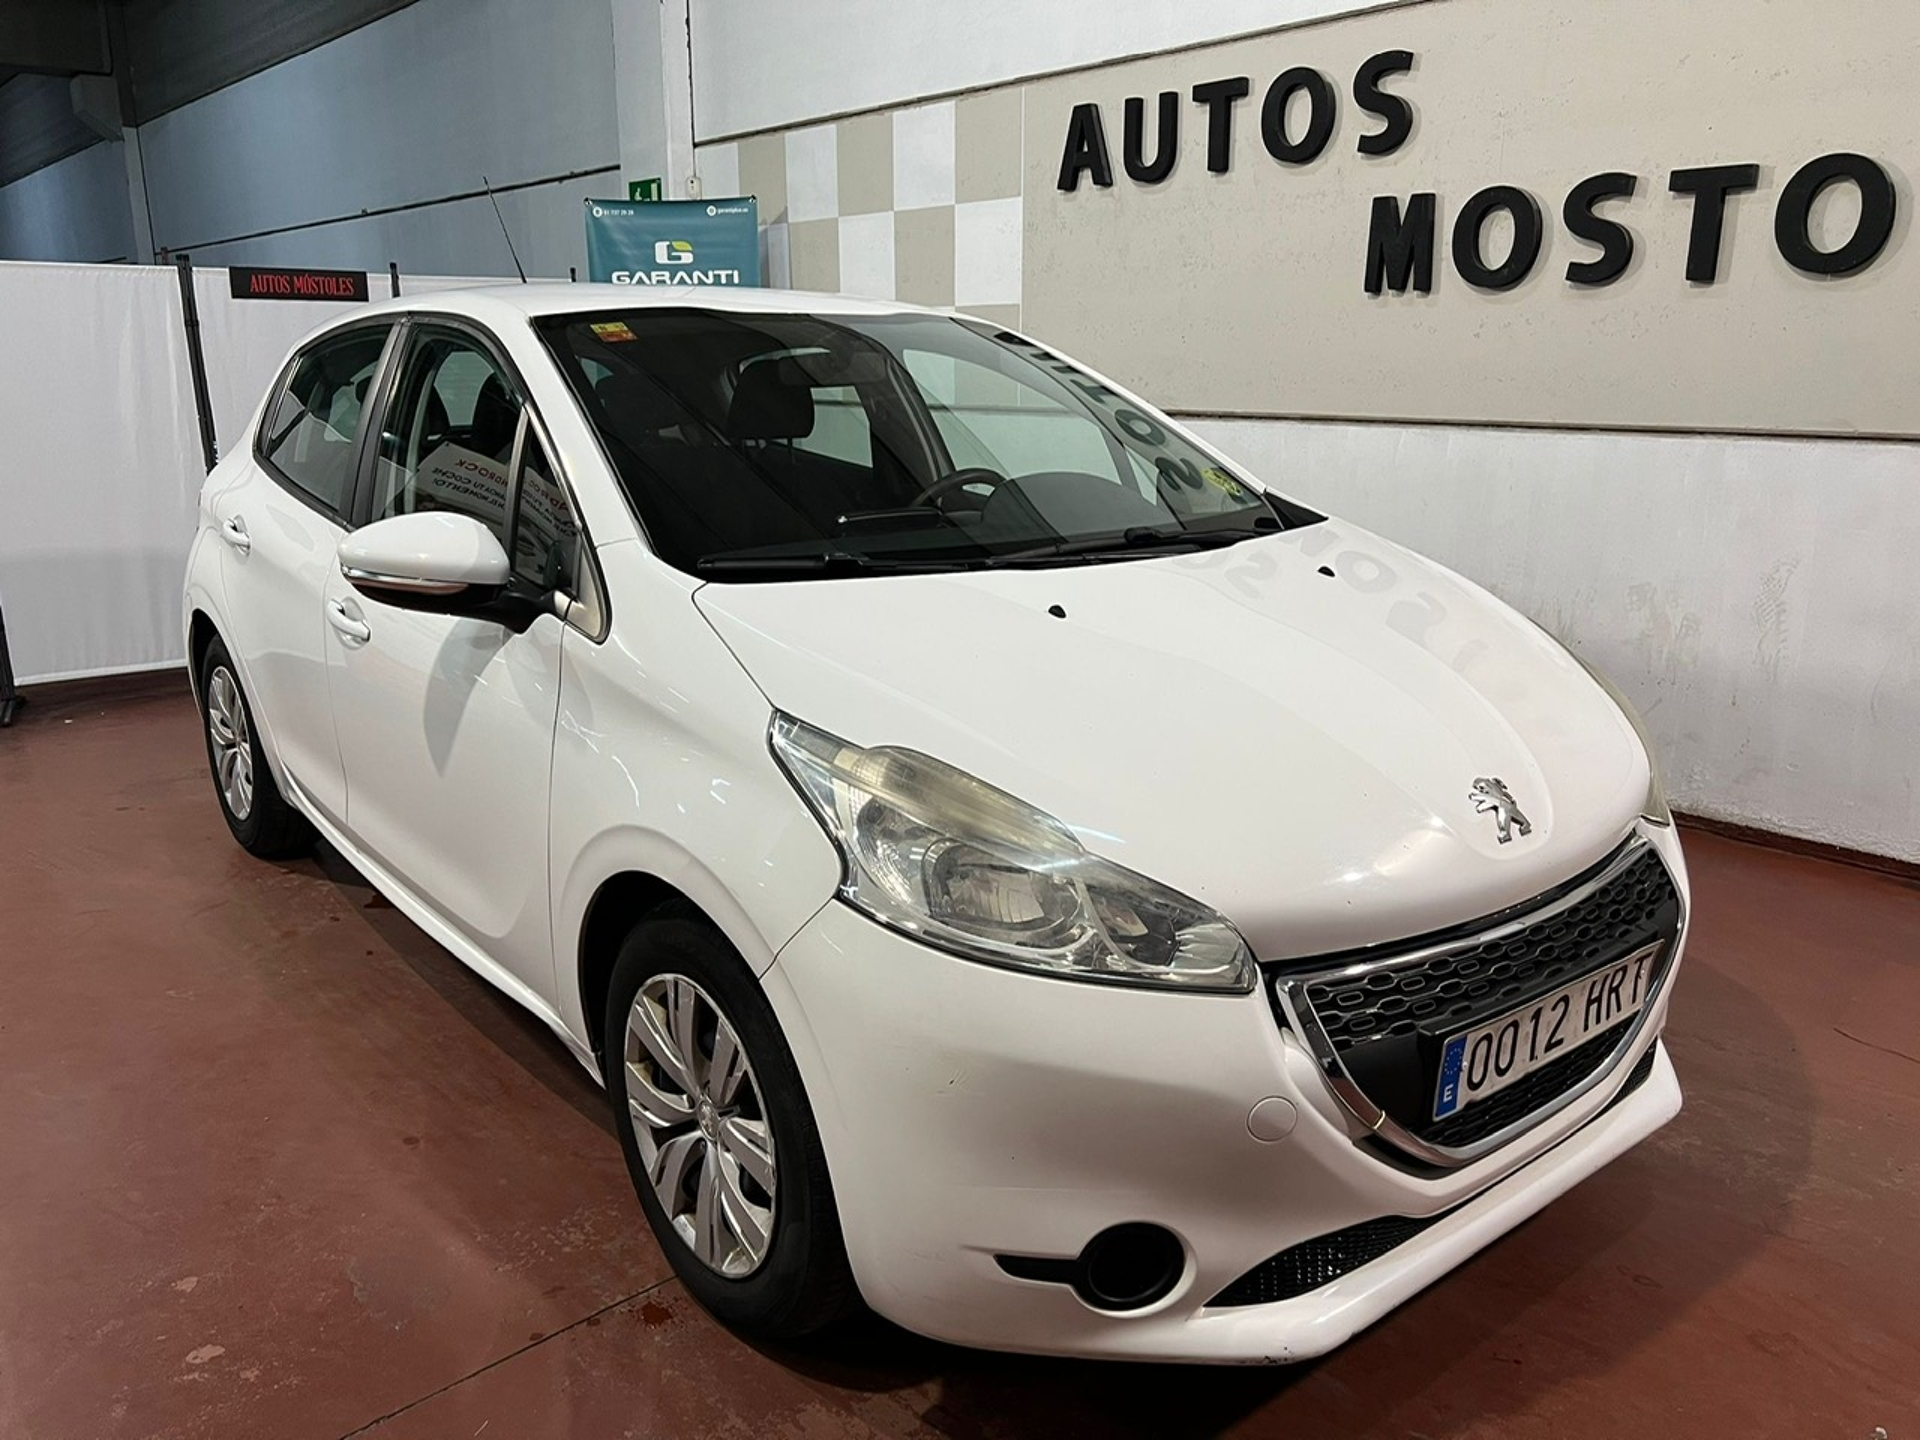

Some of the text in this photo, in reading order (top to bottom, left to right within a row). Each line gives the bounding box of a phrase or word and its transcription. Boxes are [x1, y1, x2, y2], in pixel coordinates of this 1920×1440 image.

[1057, 50, 1415, 192] AUTOS
[250, 273, 354, 296] AUTOS MÓSTOLES
[611, 270, 740, 285] GARANTI
[1364, 152, 1897, 296] MOSTO
[1467, 952, 1655, 1091] 0012 HRT
